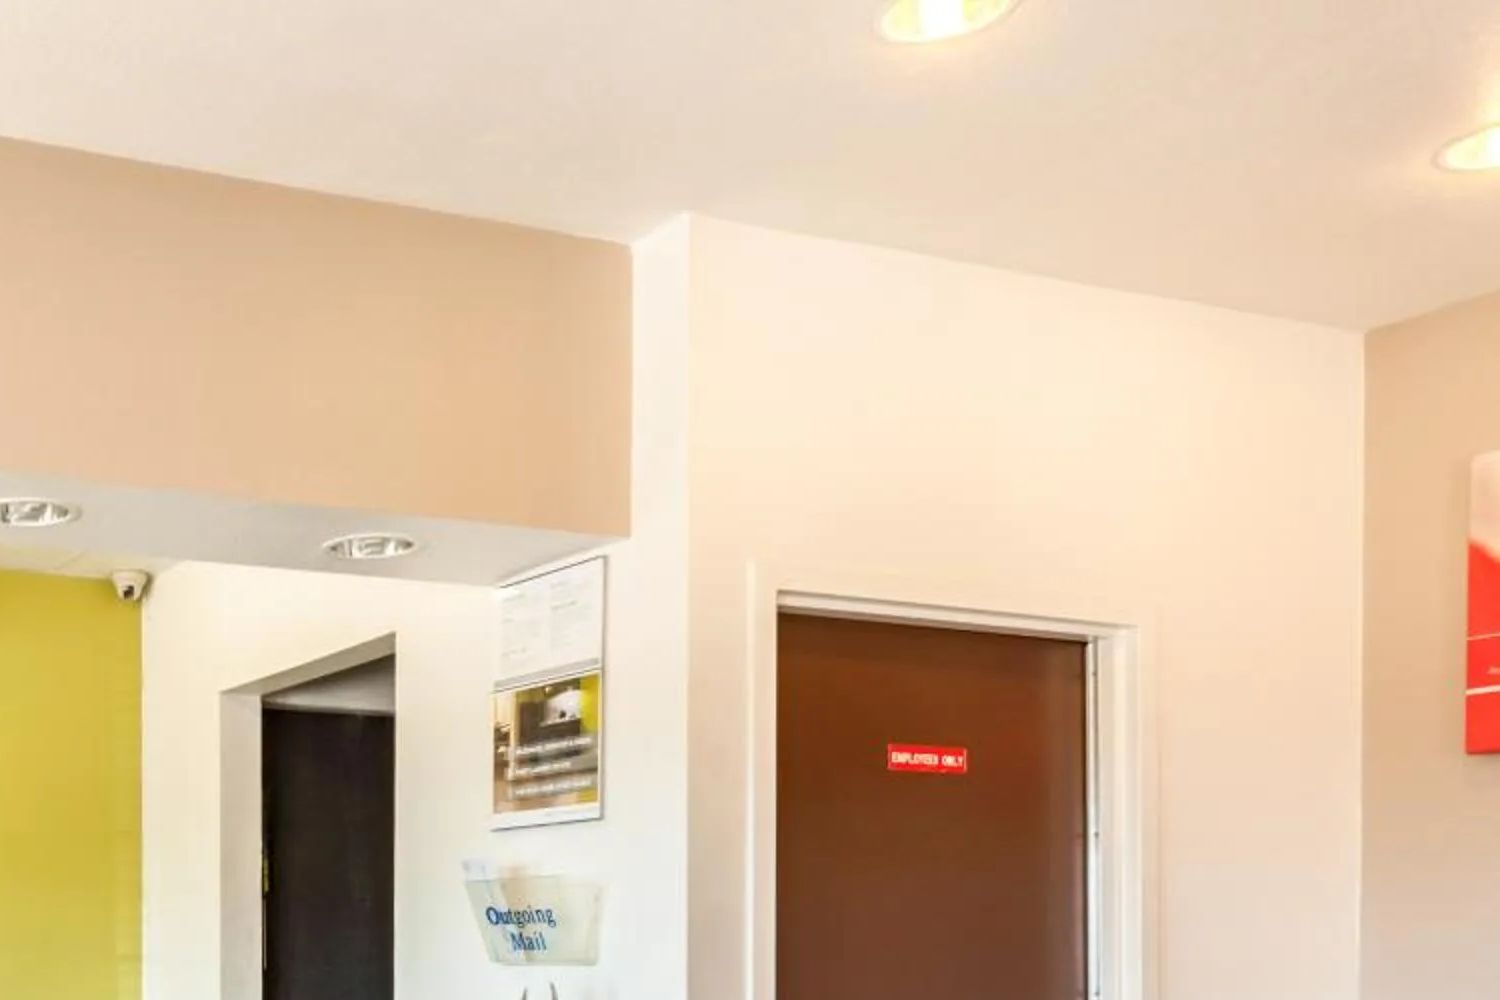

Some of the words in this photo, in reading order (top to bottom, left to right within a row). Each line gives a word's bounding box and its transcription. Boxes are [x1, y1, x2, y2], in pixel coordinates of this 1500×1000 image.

[941, 754, 963, 767] ONLY
[485, 905, 557, 929] Outgoing
[510, 931, 547, 951] Mail
